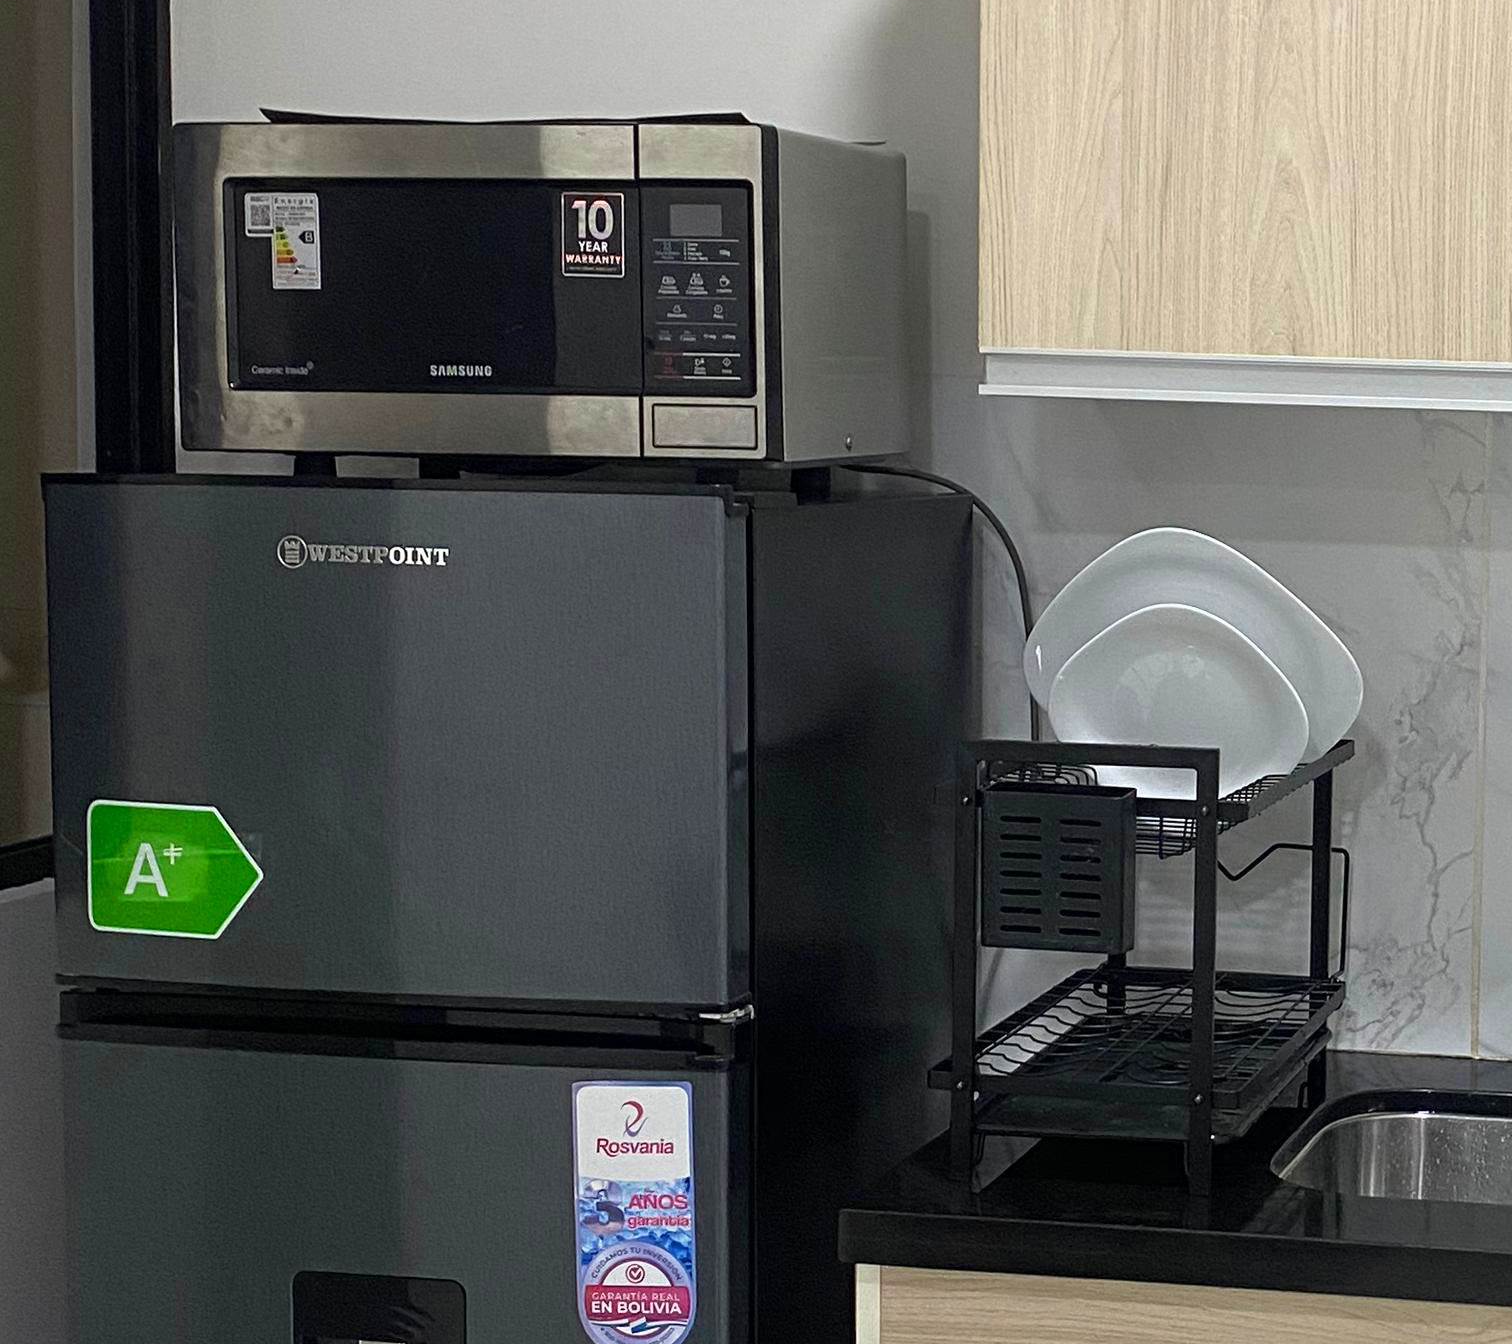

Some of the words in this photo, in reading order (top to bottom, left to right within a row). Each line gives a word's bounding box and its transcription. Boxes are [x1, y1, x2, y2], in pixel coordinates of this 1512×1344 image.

[571, 200, 614, 240] 10
[578, 241, 608, 253] YEAR
[565, 254, 622, 265] WARRANTY
[430, 365, 492, 376] SAMSUNG
[308, 543, 449, 566] WESTPOINT
[596, 1137, 675, 1157] Rosvania
[628, 1188, 688, 1210] AÑOS
[591, 1248, 628, 1279] CUIDAMOS
[591, 1290, 648, 1301] GARANTÍA
[651, 1292, 680, 1301] REAL
[591, 1301, 613, 1313] EN
[617, 1301, 682, 1314] BOLIVIA
